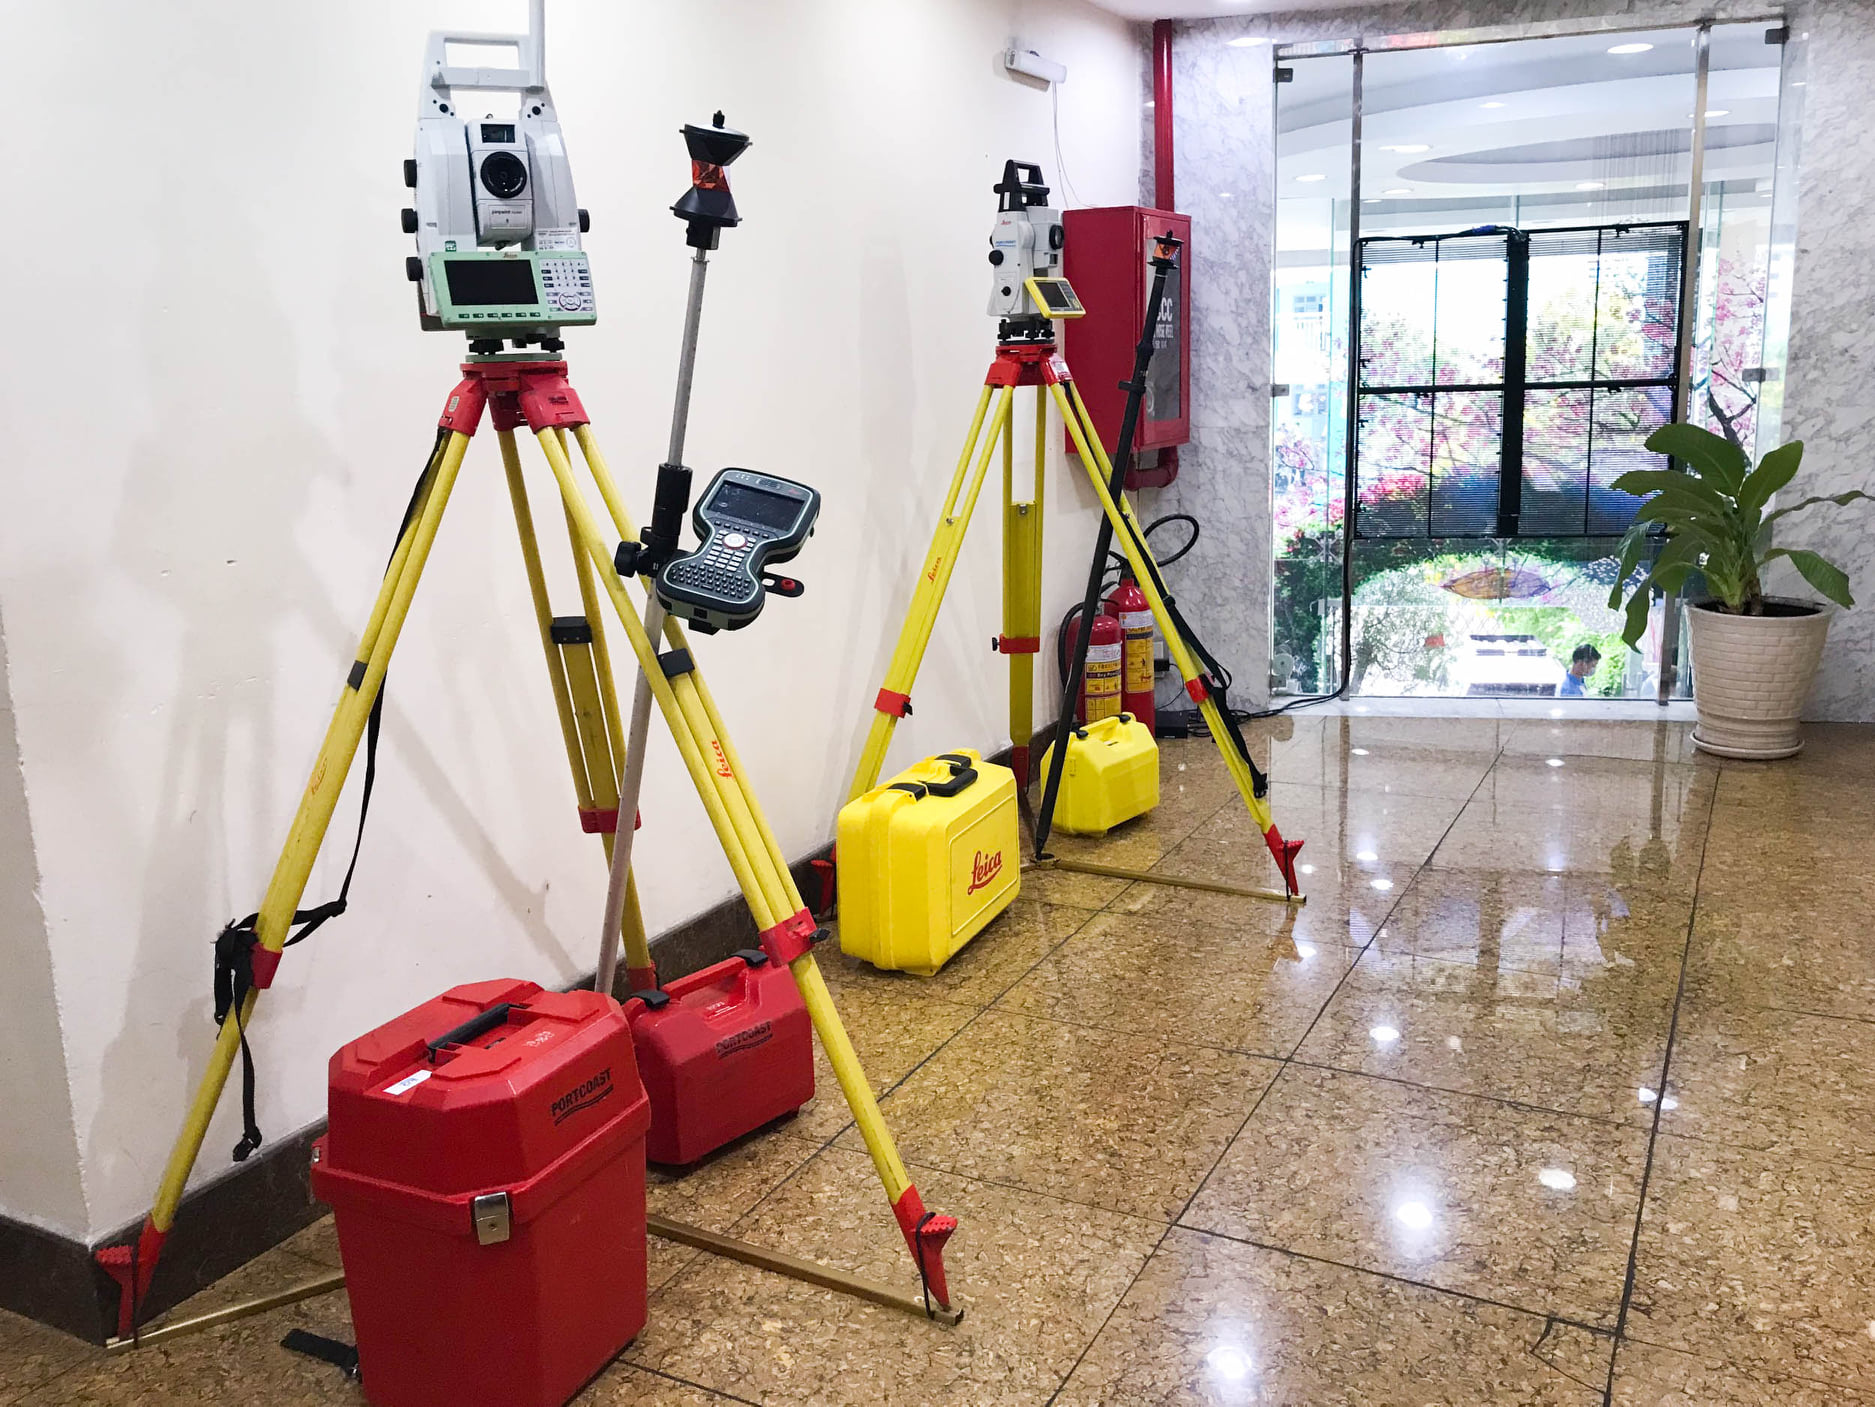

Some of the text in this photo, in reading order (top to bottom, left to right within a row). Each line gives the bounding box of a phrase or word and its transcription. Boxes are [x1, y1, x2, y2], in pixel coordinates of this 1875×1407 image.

[711, 740, 735, 779] Leica
[967, 849, 1003, 896] Leica
[715, 1020, 772, 1054] PORTCOAST
[551, 1067, 612, 1116] PORTCOAST
